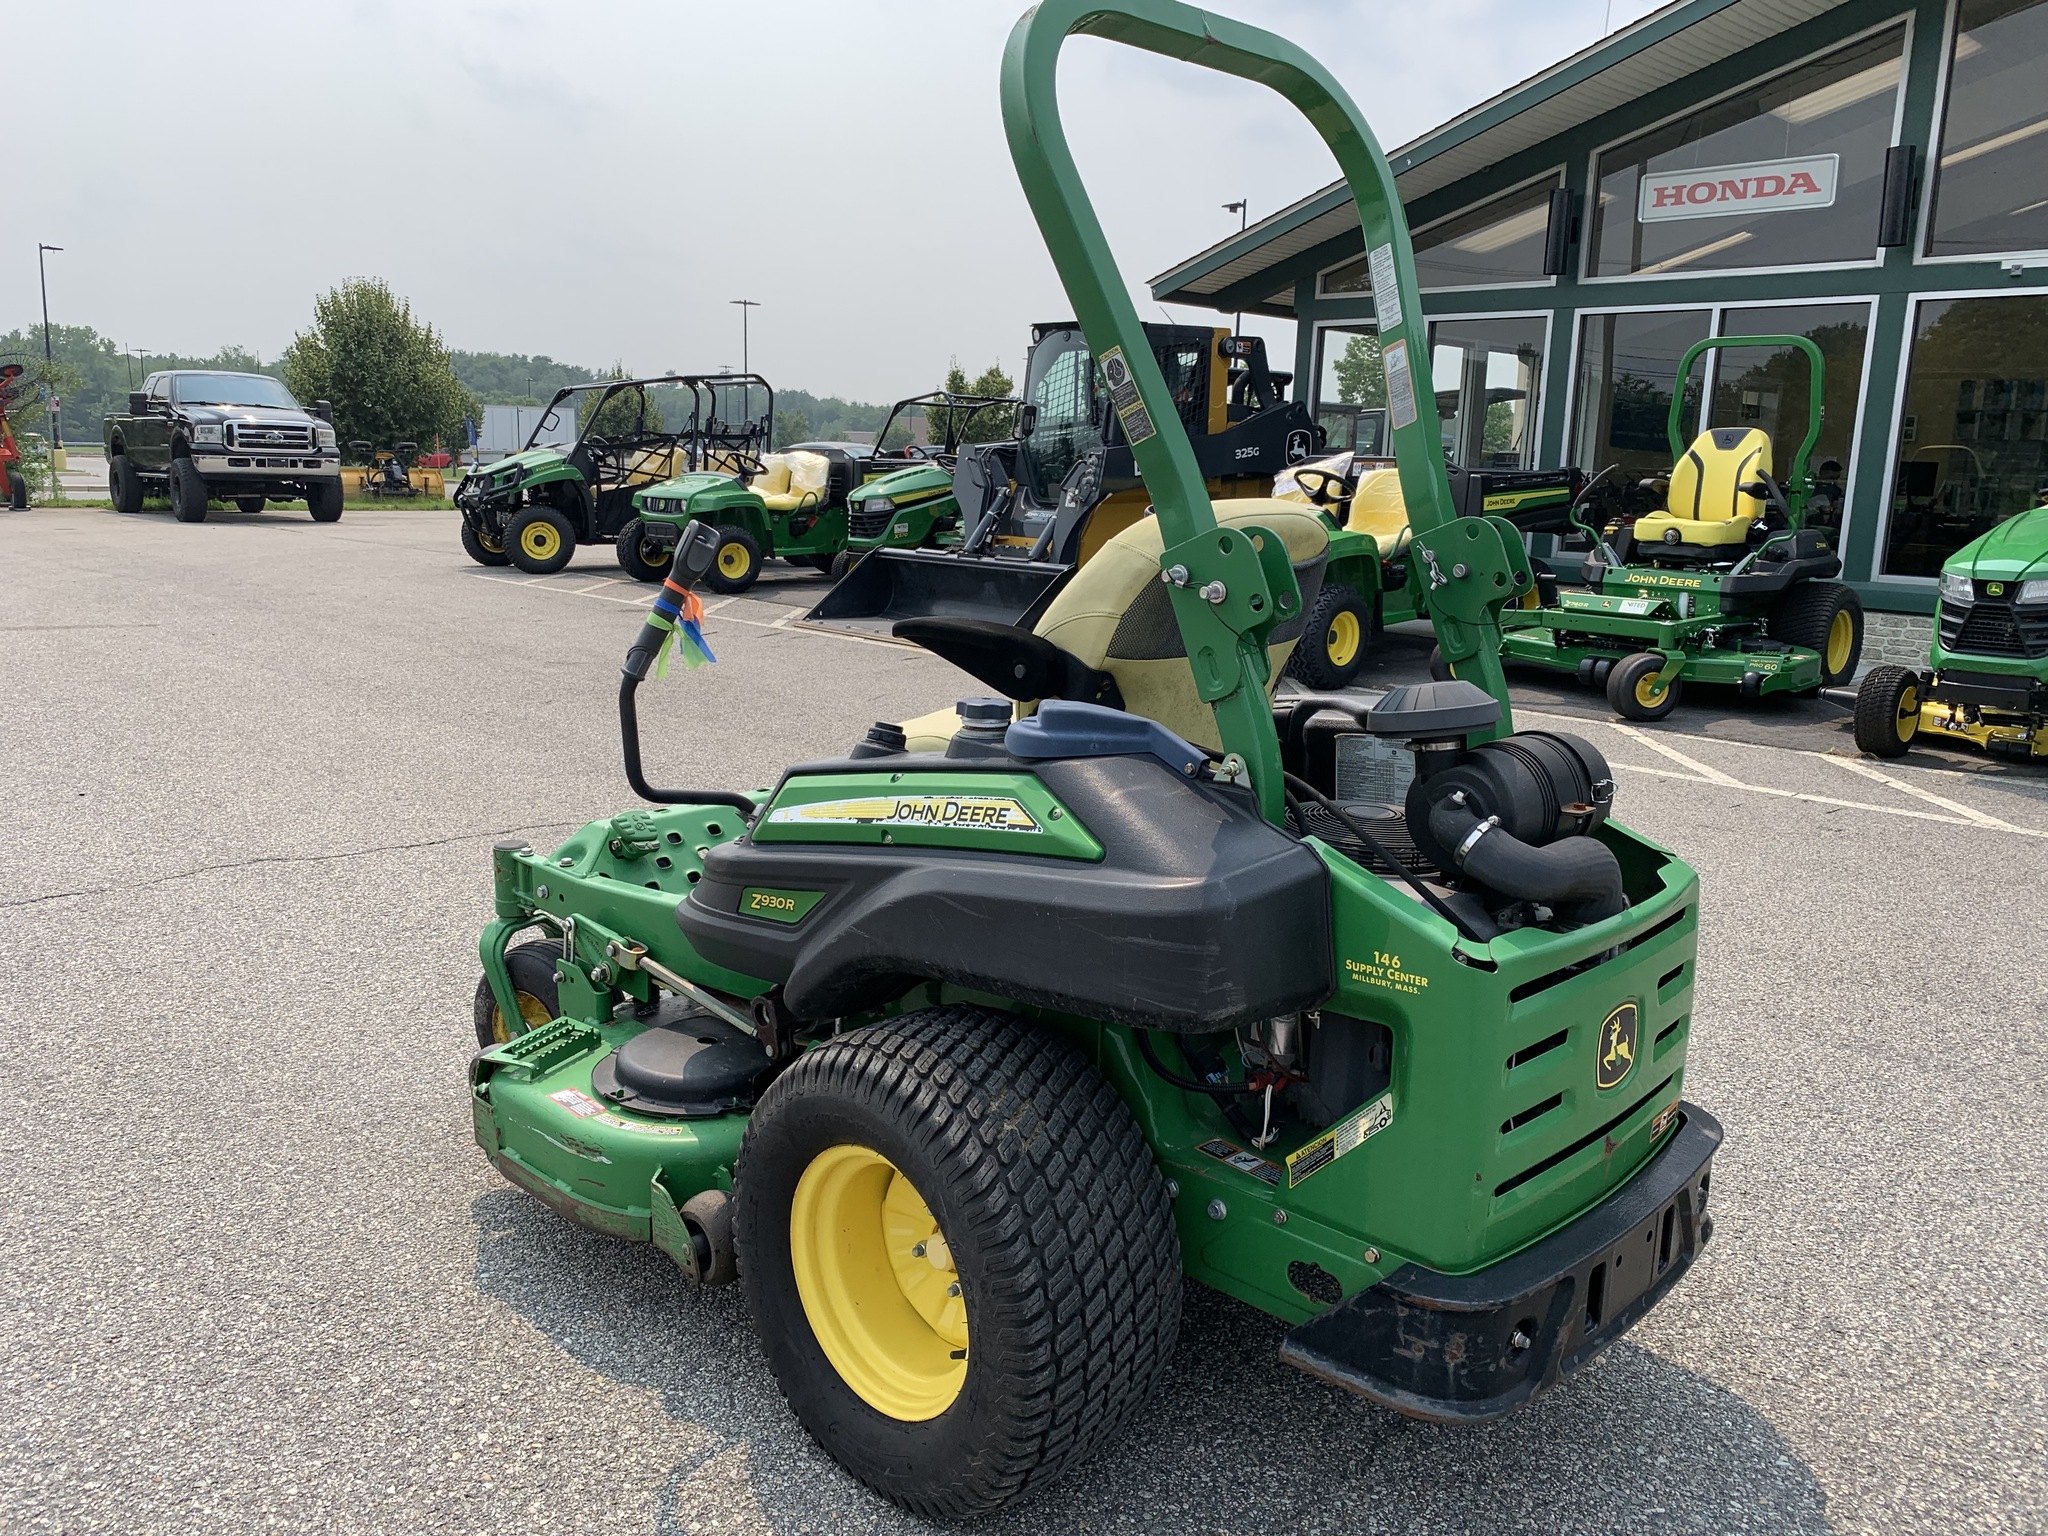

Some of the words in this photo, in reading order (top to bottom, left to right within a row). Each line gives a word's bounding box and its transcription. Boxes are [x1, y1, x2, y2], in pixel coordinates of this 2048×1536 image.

[1652, 172, 1821, 208] HONDA
[1235, 447, 1260, 460] 325G
[1624, 573, 1658, 585] JOHN
[1659, 576, 1701, 588] DEERE
[887, 801, 940, 821] JOHN
[942, 801, 1011, 824] DEERE
[751, 893, 795, 911] Z930R
[1373, 951, 1401, 969] 146
[1345, 959, 1384, 977] SUPPLY
[1387, 968, 1429, 988] CENTER
[1351, 973, 1393, 990] MILLBURY,
[1395, 983, 1421, 995] MASS.
